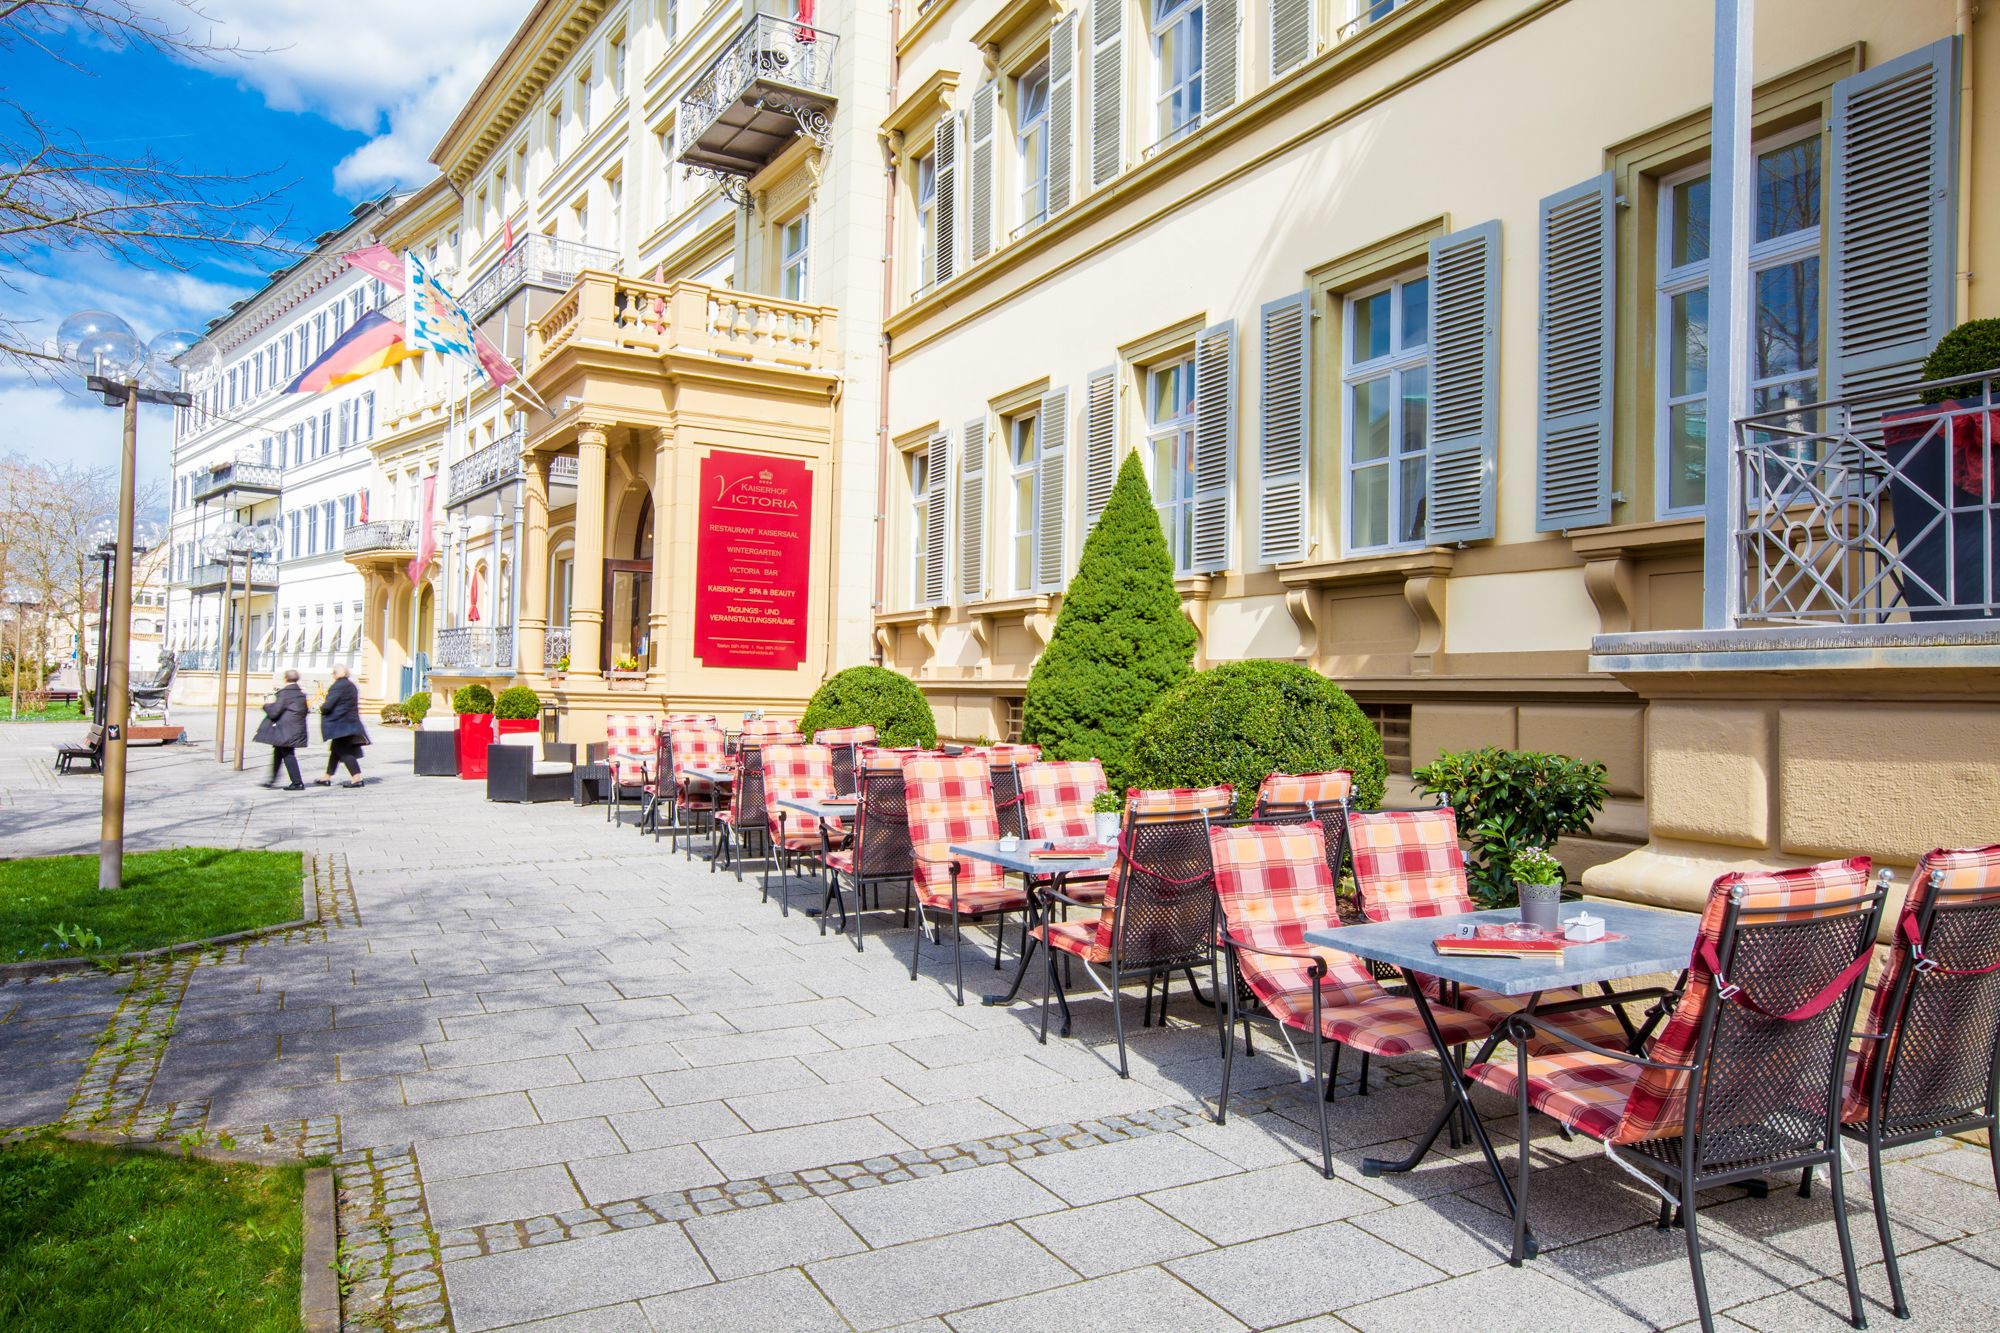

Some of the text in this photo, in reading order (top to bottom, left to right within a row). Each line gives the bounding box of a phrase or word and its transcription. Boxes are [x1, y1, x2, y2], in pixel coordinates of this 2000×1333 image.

[713, 475, 798, 510] VICTORIA
[709, 524, 799, 539] RESTAURANT KAISERSAAL
[727, 546, 782, 557] WINTERGARTEN
[729, 566, 760, 575] VICTORIA
[708, 585, 745, 594] KAISERHOF
[749, 587, 762, 595] SPA
[770, 589, 795, 597] BEAUTY
[726, 606, 762, 614] TAGUNGS-
[709, 614, 795, 625] VERANSTALTUNGSRÄUME
[1462, 926, 1469, 935] 9
